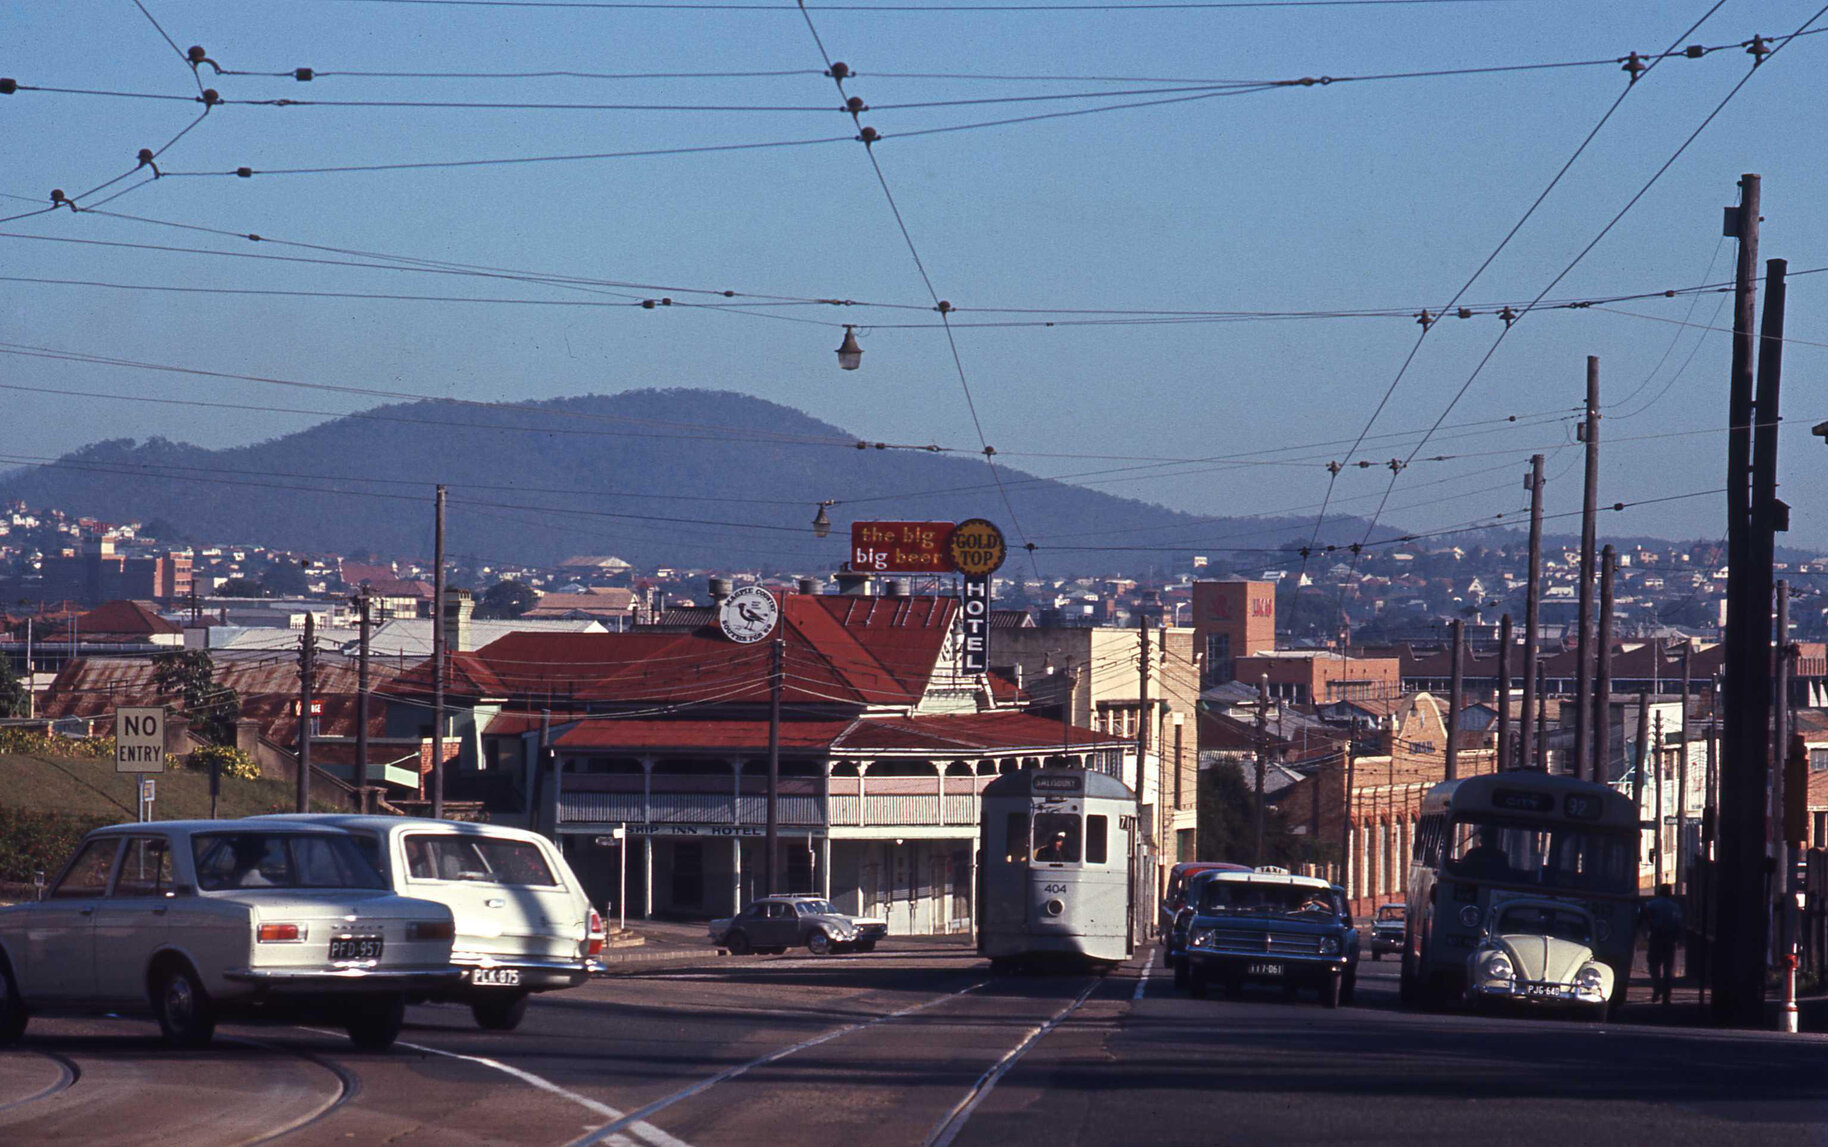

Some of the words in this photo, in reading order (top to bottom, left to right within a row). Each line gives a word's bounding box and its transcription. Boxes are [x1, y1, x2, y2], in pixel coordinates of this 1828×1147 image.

[862, 527, 895, 543] the
[903, 527, 936, 549] big
[956, 534, 997, 549] GOLD
[856, 548, 888, 570] big
[895, 548, 941, 565] beer
[960, 550, 993, 566] TOP
[966, 582, 985, 669] HOTEL
[124, 715, 157, 736] NO
[120, 745, 161, 762] ENTRY
[625, 825, 660, 835] SHIP
[672, 826, 697, 835] INN
[712, 827, 761, 836] HOTEL
[1260, 866, 1283, 874] TAXI
[1044, 884, 1067, 894] 404
